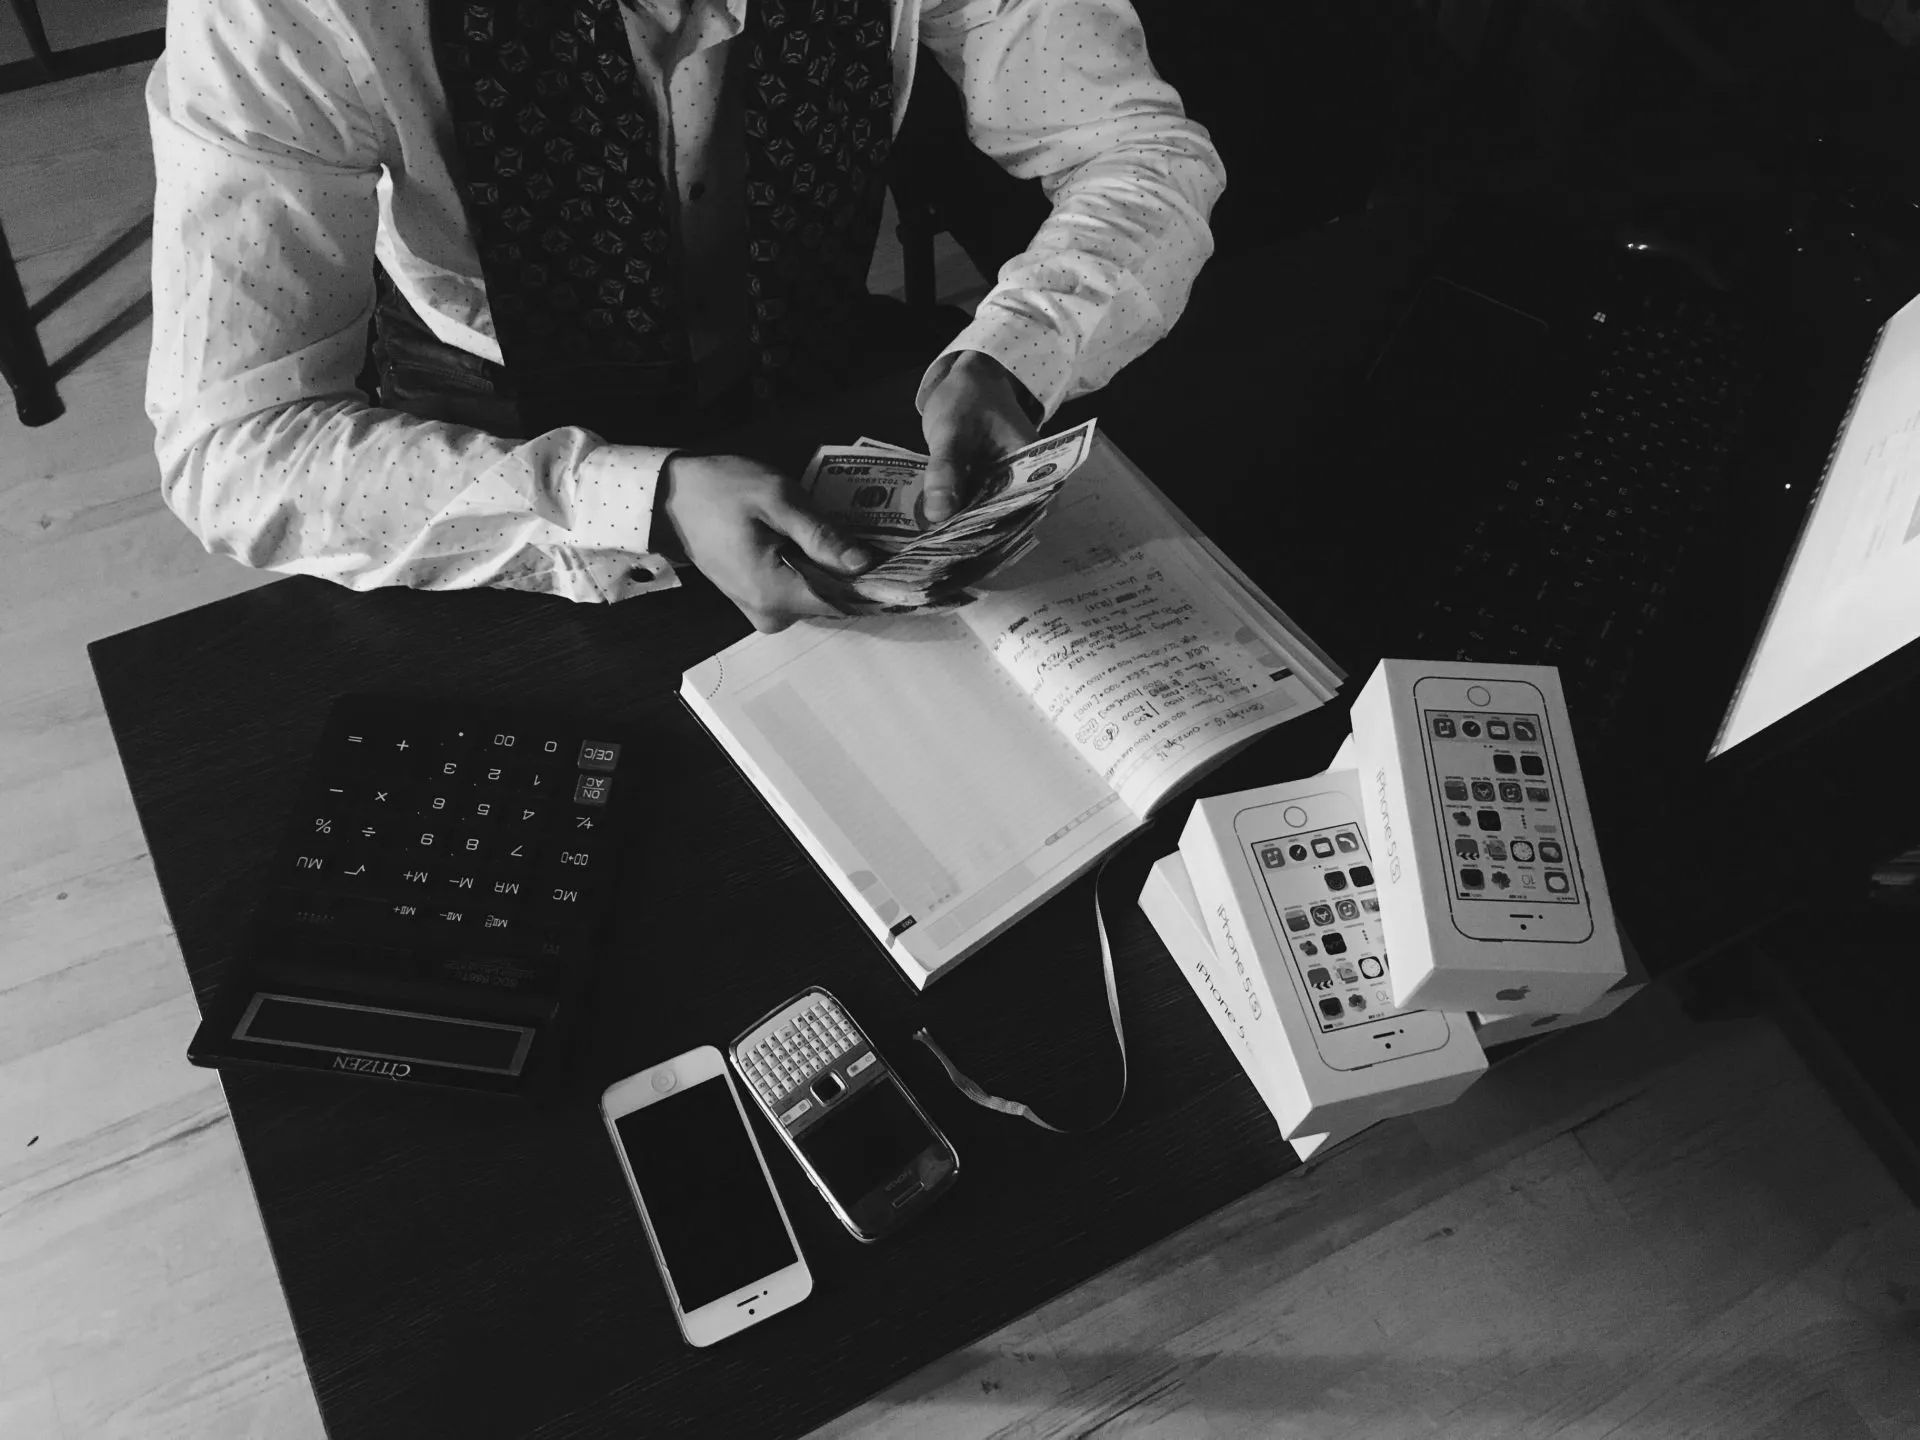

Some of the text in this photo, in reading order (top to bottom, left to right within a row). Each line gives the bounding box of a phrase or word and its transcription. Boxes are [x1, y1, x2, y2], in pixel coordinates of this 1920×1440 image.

[494, 734, 515, 748] 00
[583, 748, 614, 762] CE/C
[443, 762, 541, 787] 3 2 1
[586, 777, 605, 788] AC
[583, 789, 601, 800] ON
[1375, 767, 1393, 839] iPhone
[432, 797, 446, 810] 6
[477, 803, 490, 816] 5
[522, 808, 535, 821] 4
[420, 833, 434, 846] 9
[466, 838, 479, 851] 8
[510, 845, 523, 858] 7
[296, 856, 323, 870] MU
[403, 870, 428, 883] M+
[449, 876, 474, 889] M-
[494, 881, 519, 895] MR
[553, 888, 578, 902] MC
[1216, 904, 1245, 976] iPhone
[1196, 961, 1237, 1025] iPhone
[332, 1055, 411, 1082] CITIZEN
